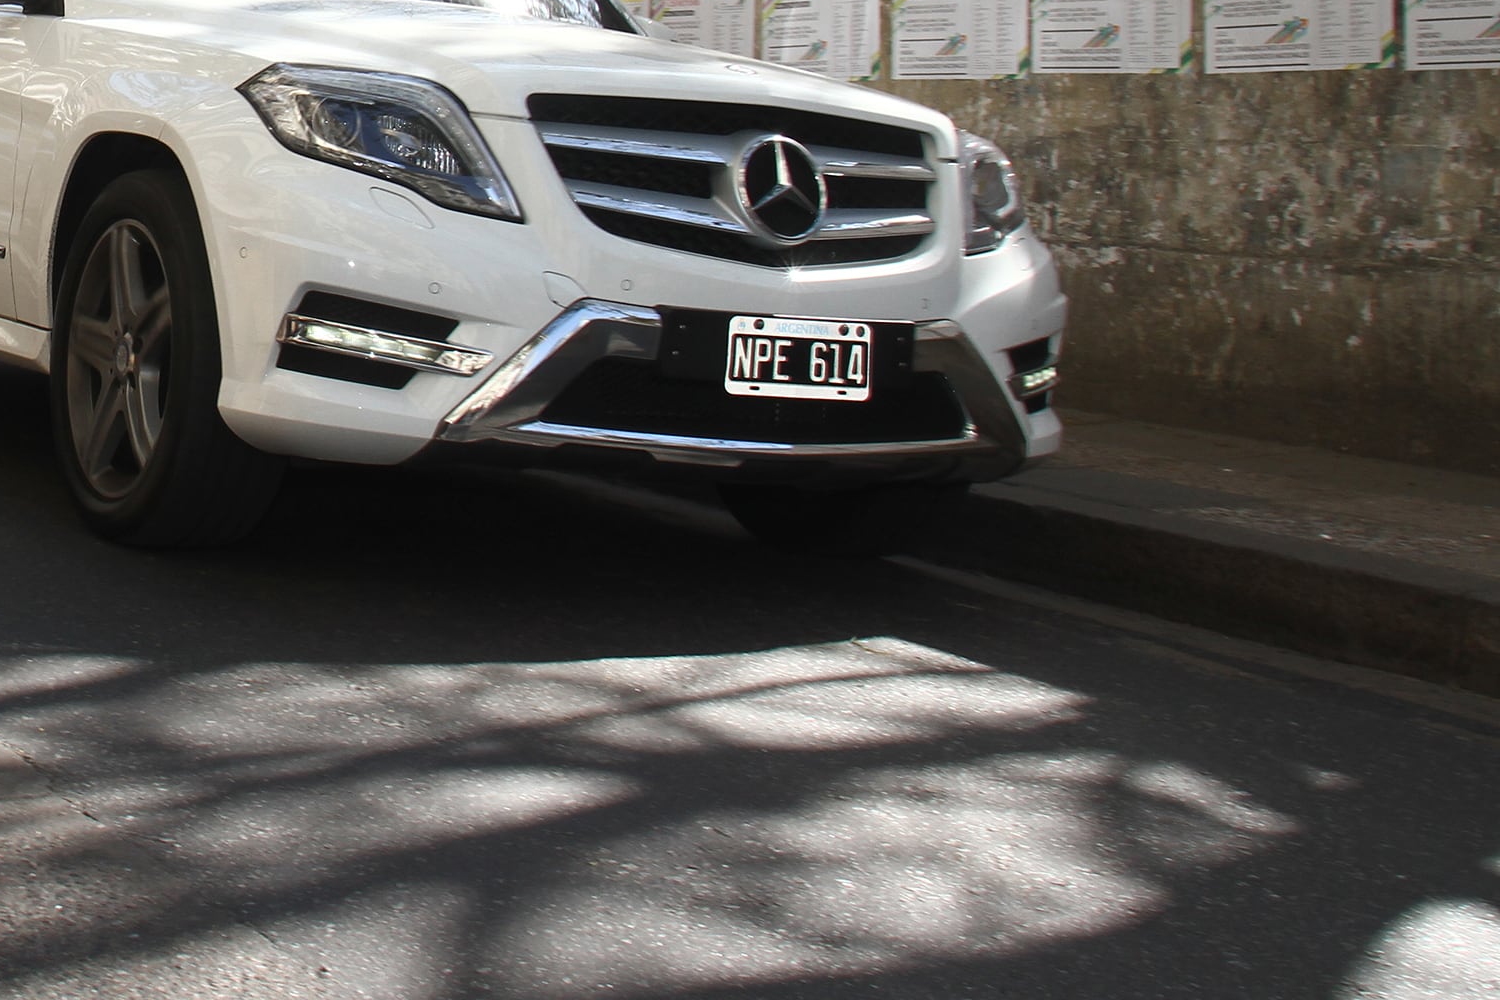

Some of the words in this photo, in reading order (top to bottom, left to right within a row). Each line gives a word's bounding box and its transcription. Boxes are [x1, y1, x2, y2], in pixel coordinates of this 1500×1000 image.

[775, 323, 830, 336] ARGENTINA
[733, 337, 793, 381] NPE
[809, 342, 864, 385] 614
